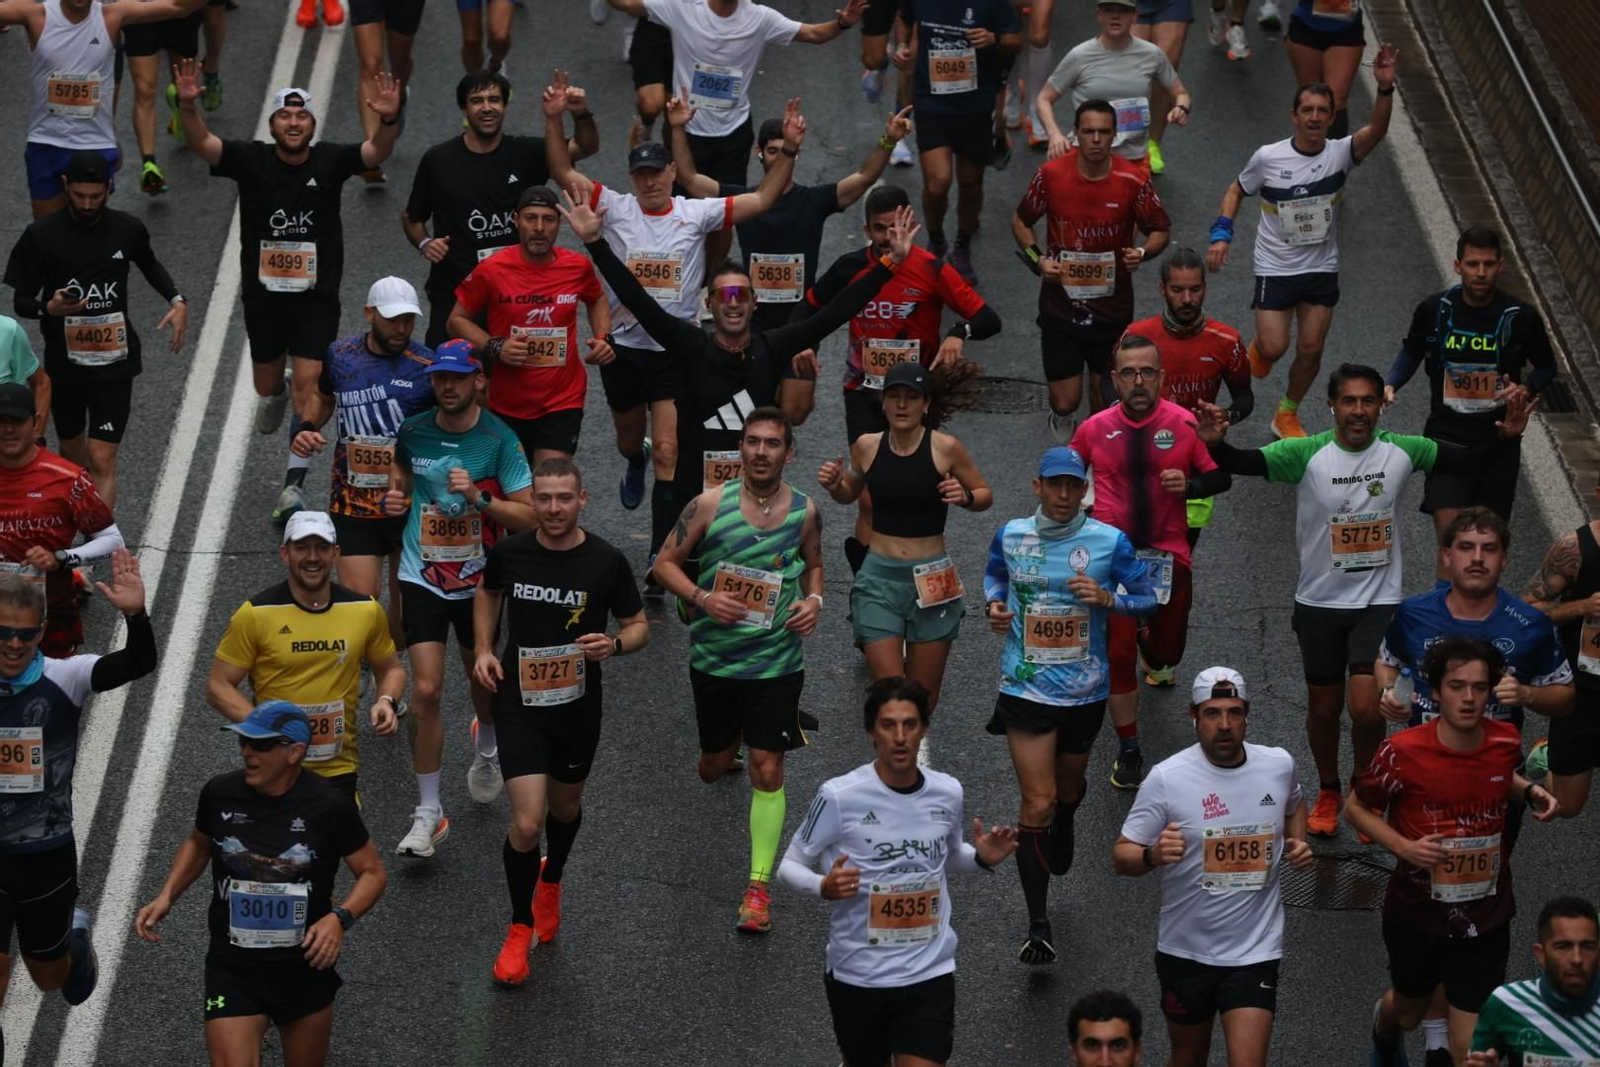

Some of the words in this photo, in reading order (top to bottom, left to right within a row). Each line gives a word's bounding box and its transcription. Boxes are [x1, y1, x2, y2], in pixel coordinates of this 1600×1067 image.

[936, 60, 966, 75] 6049
[55, 83, 89, 99] 5785
[698, 75, 731, 92] 2062
[476, 227, 512, 239] STUDIO
[268, 254, 303, 270] 4399
[635, 263, 671, 279] 5546
[758, 265, 791, 282] 5638
[1068, 264, 1103, 279] 5699
[86, 300, 113, 310] UDIO
[498, 294, 512, 304] LA
[515, 294, 554, 305] CURSA
[524, 305, 556, 325] 21K
[75, 327, 113, 344] 4402
[527, 341, 554, 357] 642
[390, 378, 413, 389] HOKA
[341, 384, 387, 406] MARATÓN
[355, 448, 392, 467] 5353
[714, 464, 744, 481] 527
[428, 519, 467, 537] 3866
[1341, 525, 1381, 544] 5775
[512, 582, 587, 607] REDOLAT
[723, 577, 764, 602] 5176
[1033, 620, 1074, 638] 4695
[528, 659, 570, 681] 3727
[310, 718, 329, 736] 28
[0, 744, 24, 764] 96
[1215, 840, 1260, 862] 6158
[1444, 852, 1488, 874] 5716
[240, 897, 288, 919] 3010
[880, 896, 927, 918] 4535
